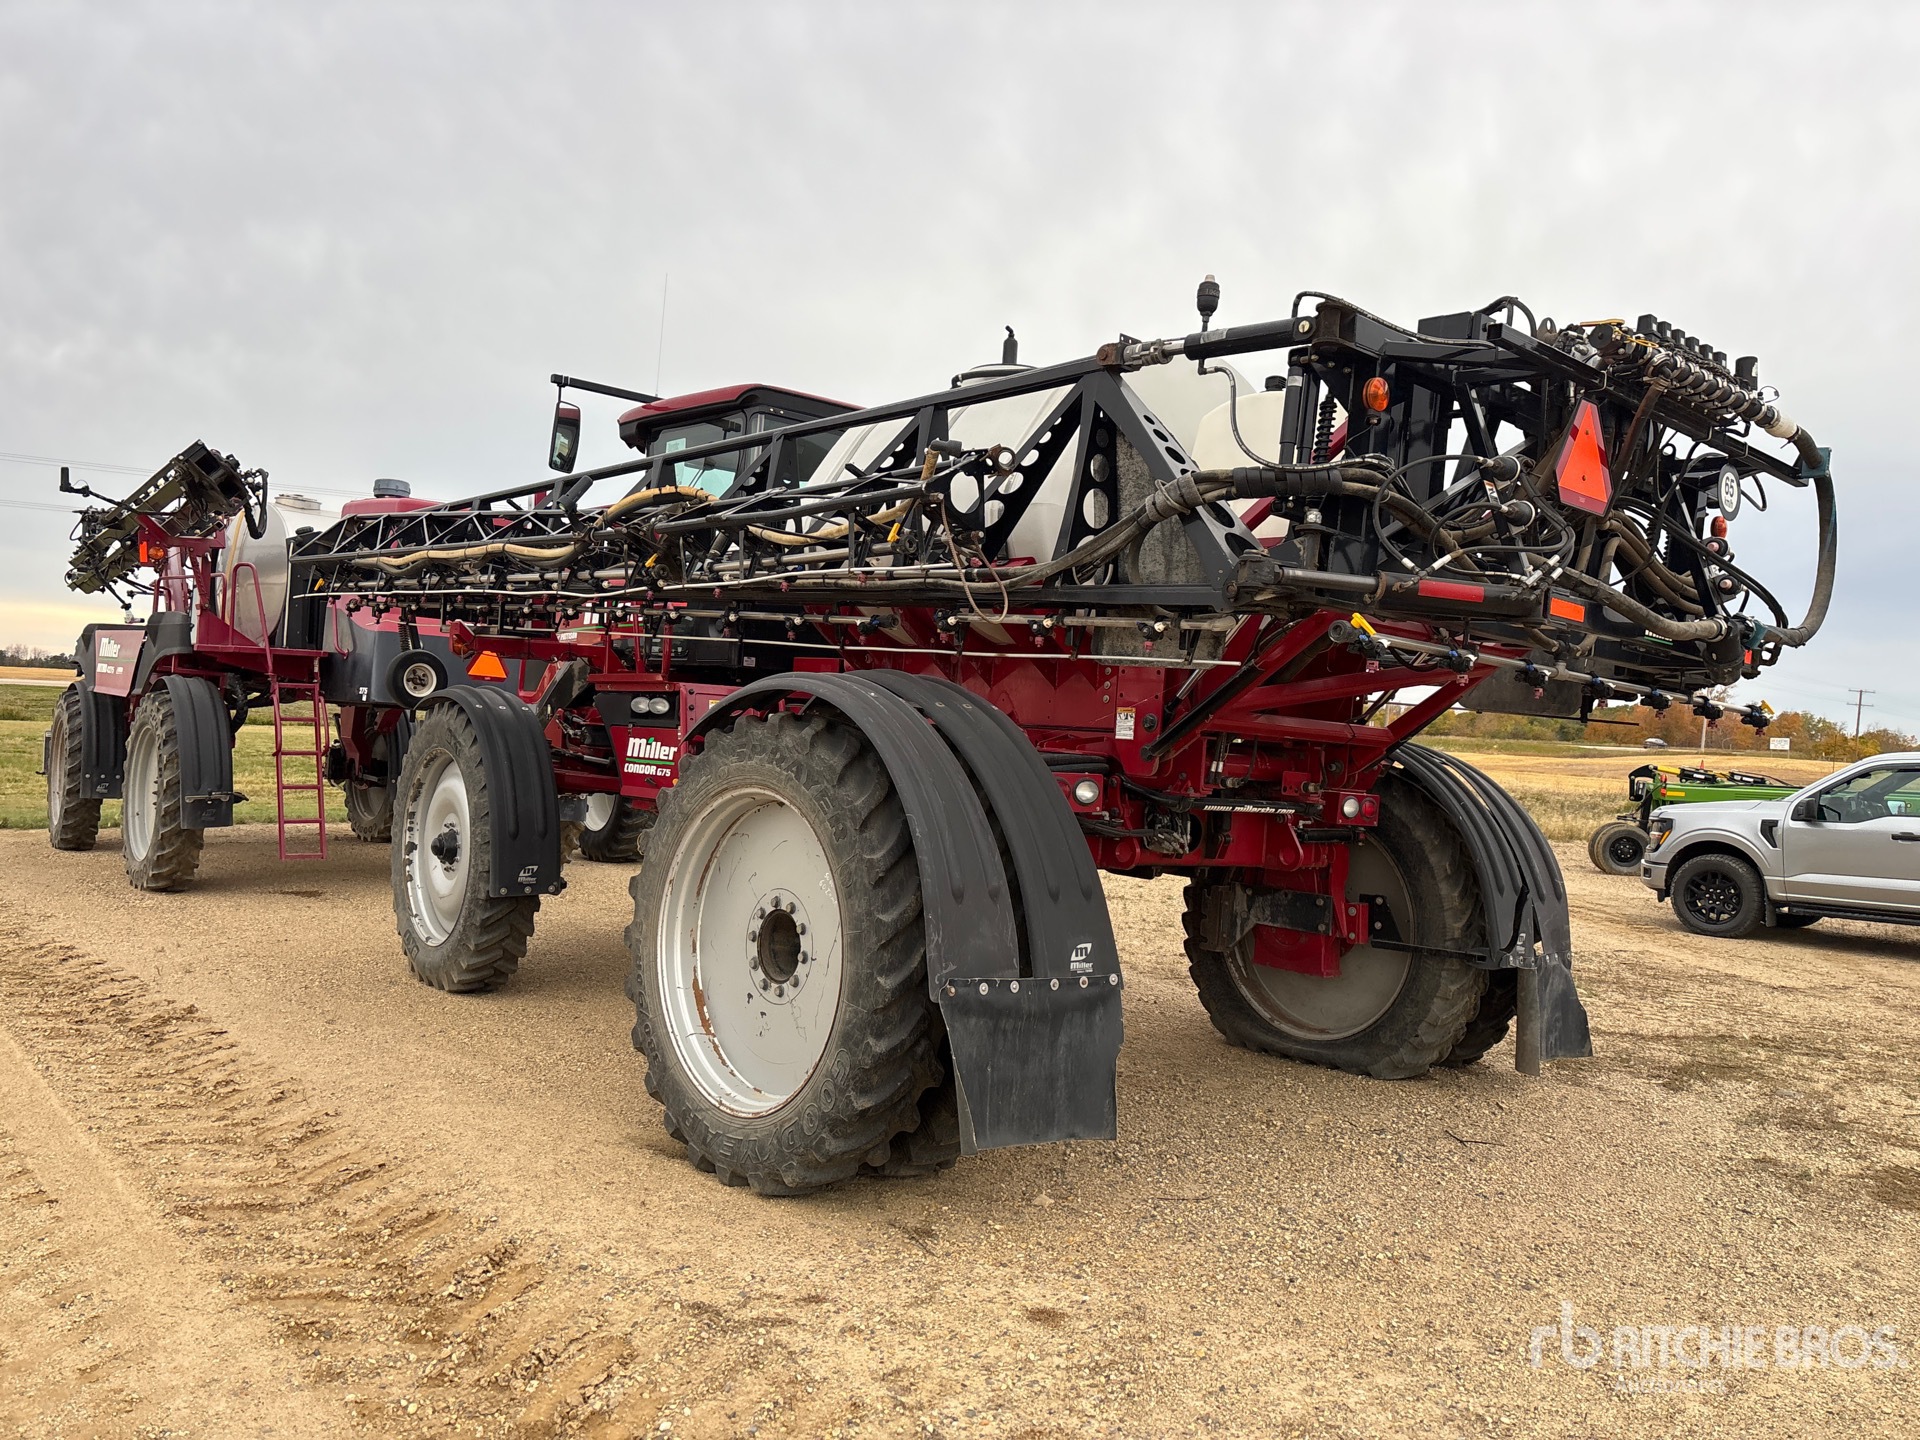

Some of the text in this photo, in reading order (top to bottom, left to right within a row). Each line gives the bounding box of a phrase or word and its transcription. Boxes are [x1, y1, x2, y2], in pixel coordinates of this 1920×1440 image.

[1724, 475, 1735, 498] 65
[99, 636, 121, 658] Miller
[626, 736, 678, 761] Miller
[623, 762, 672, 777] CONDOR G75
[1070, 961, 1093, 970] Miller
